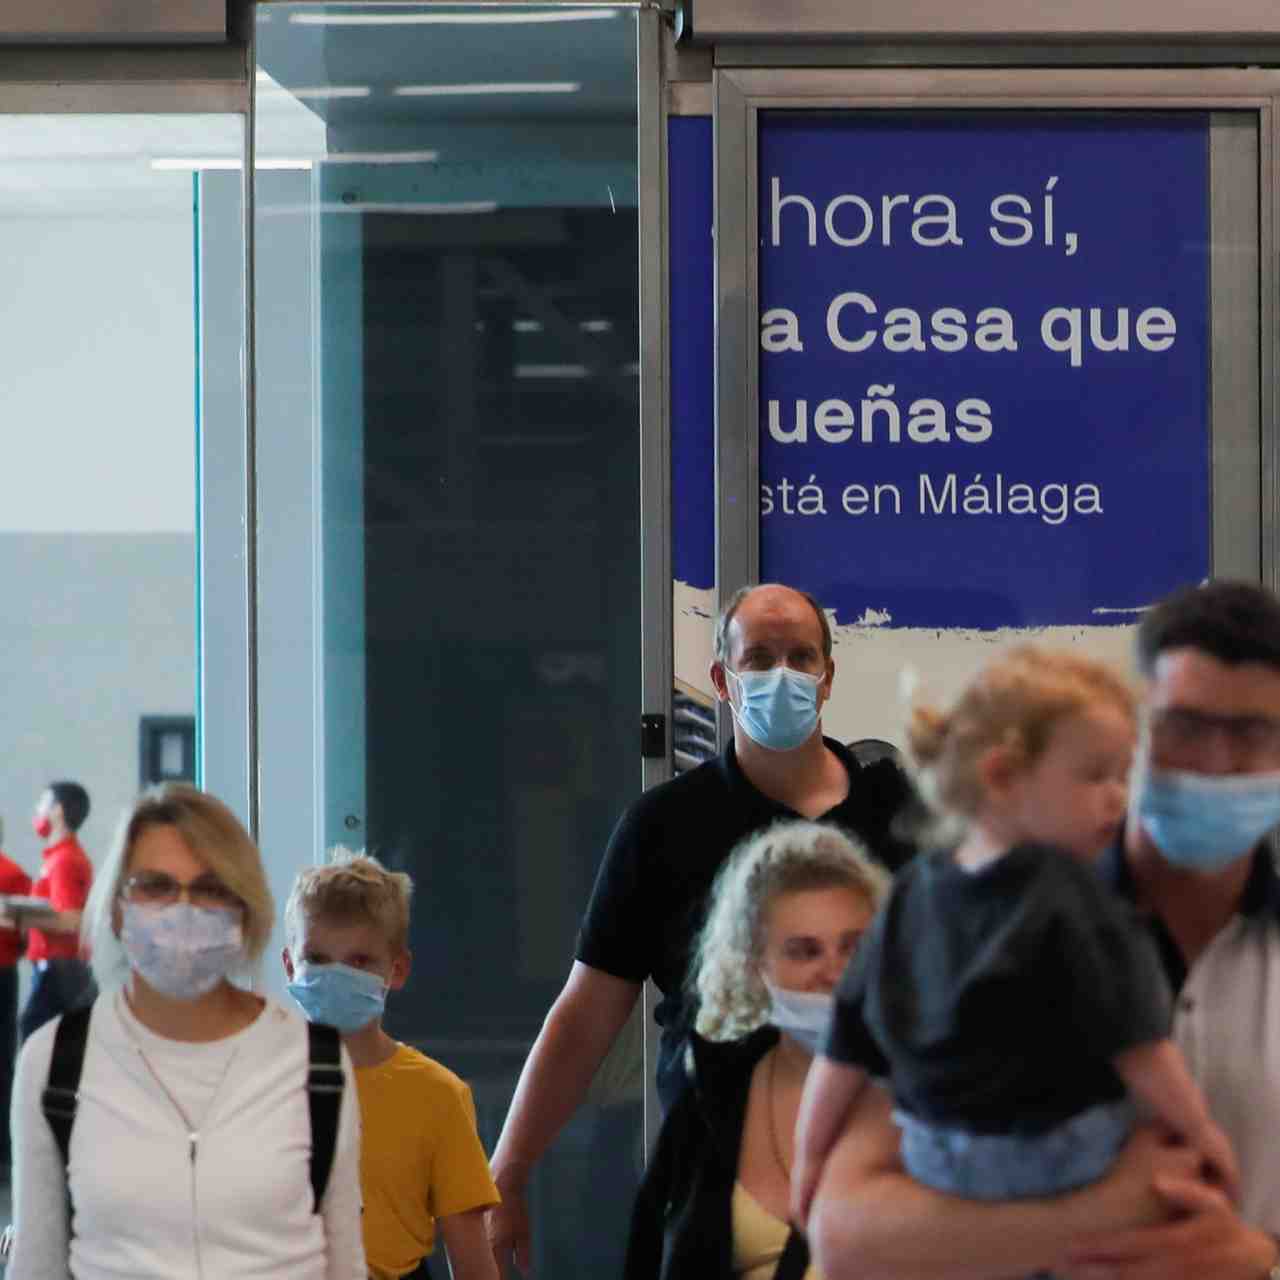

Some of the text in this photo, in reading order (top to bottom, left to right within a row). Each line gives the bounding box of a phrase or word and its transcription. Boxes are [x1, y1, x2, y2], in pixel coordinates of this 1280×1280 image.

[769, 175, 1079, 256] hora sí,
[759, 290, 1178, 368] a Casa que
[768, 383, 993, 444] ueñas
[759, 473, 1104, 525] stá en Málaga
